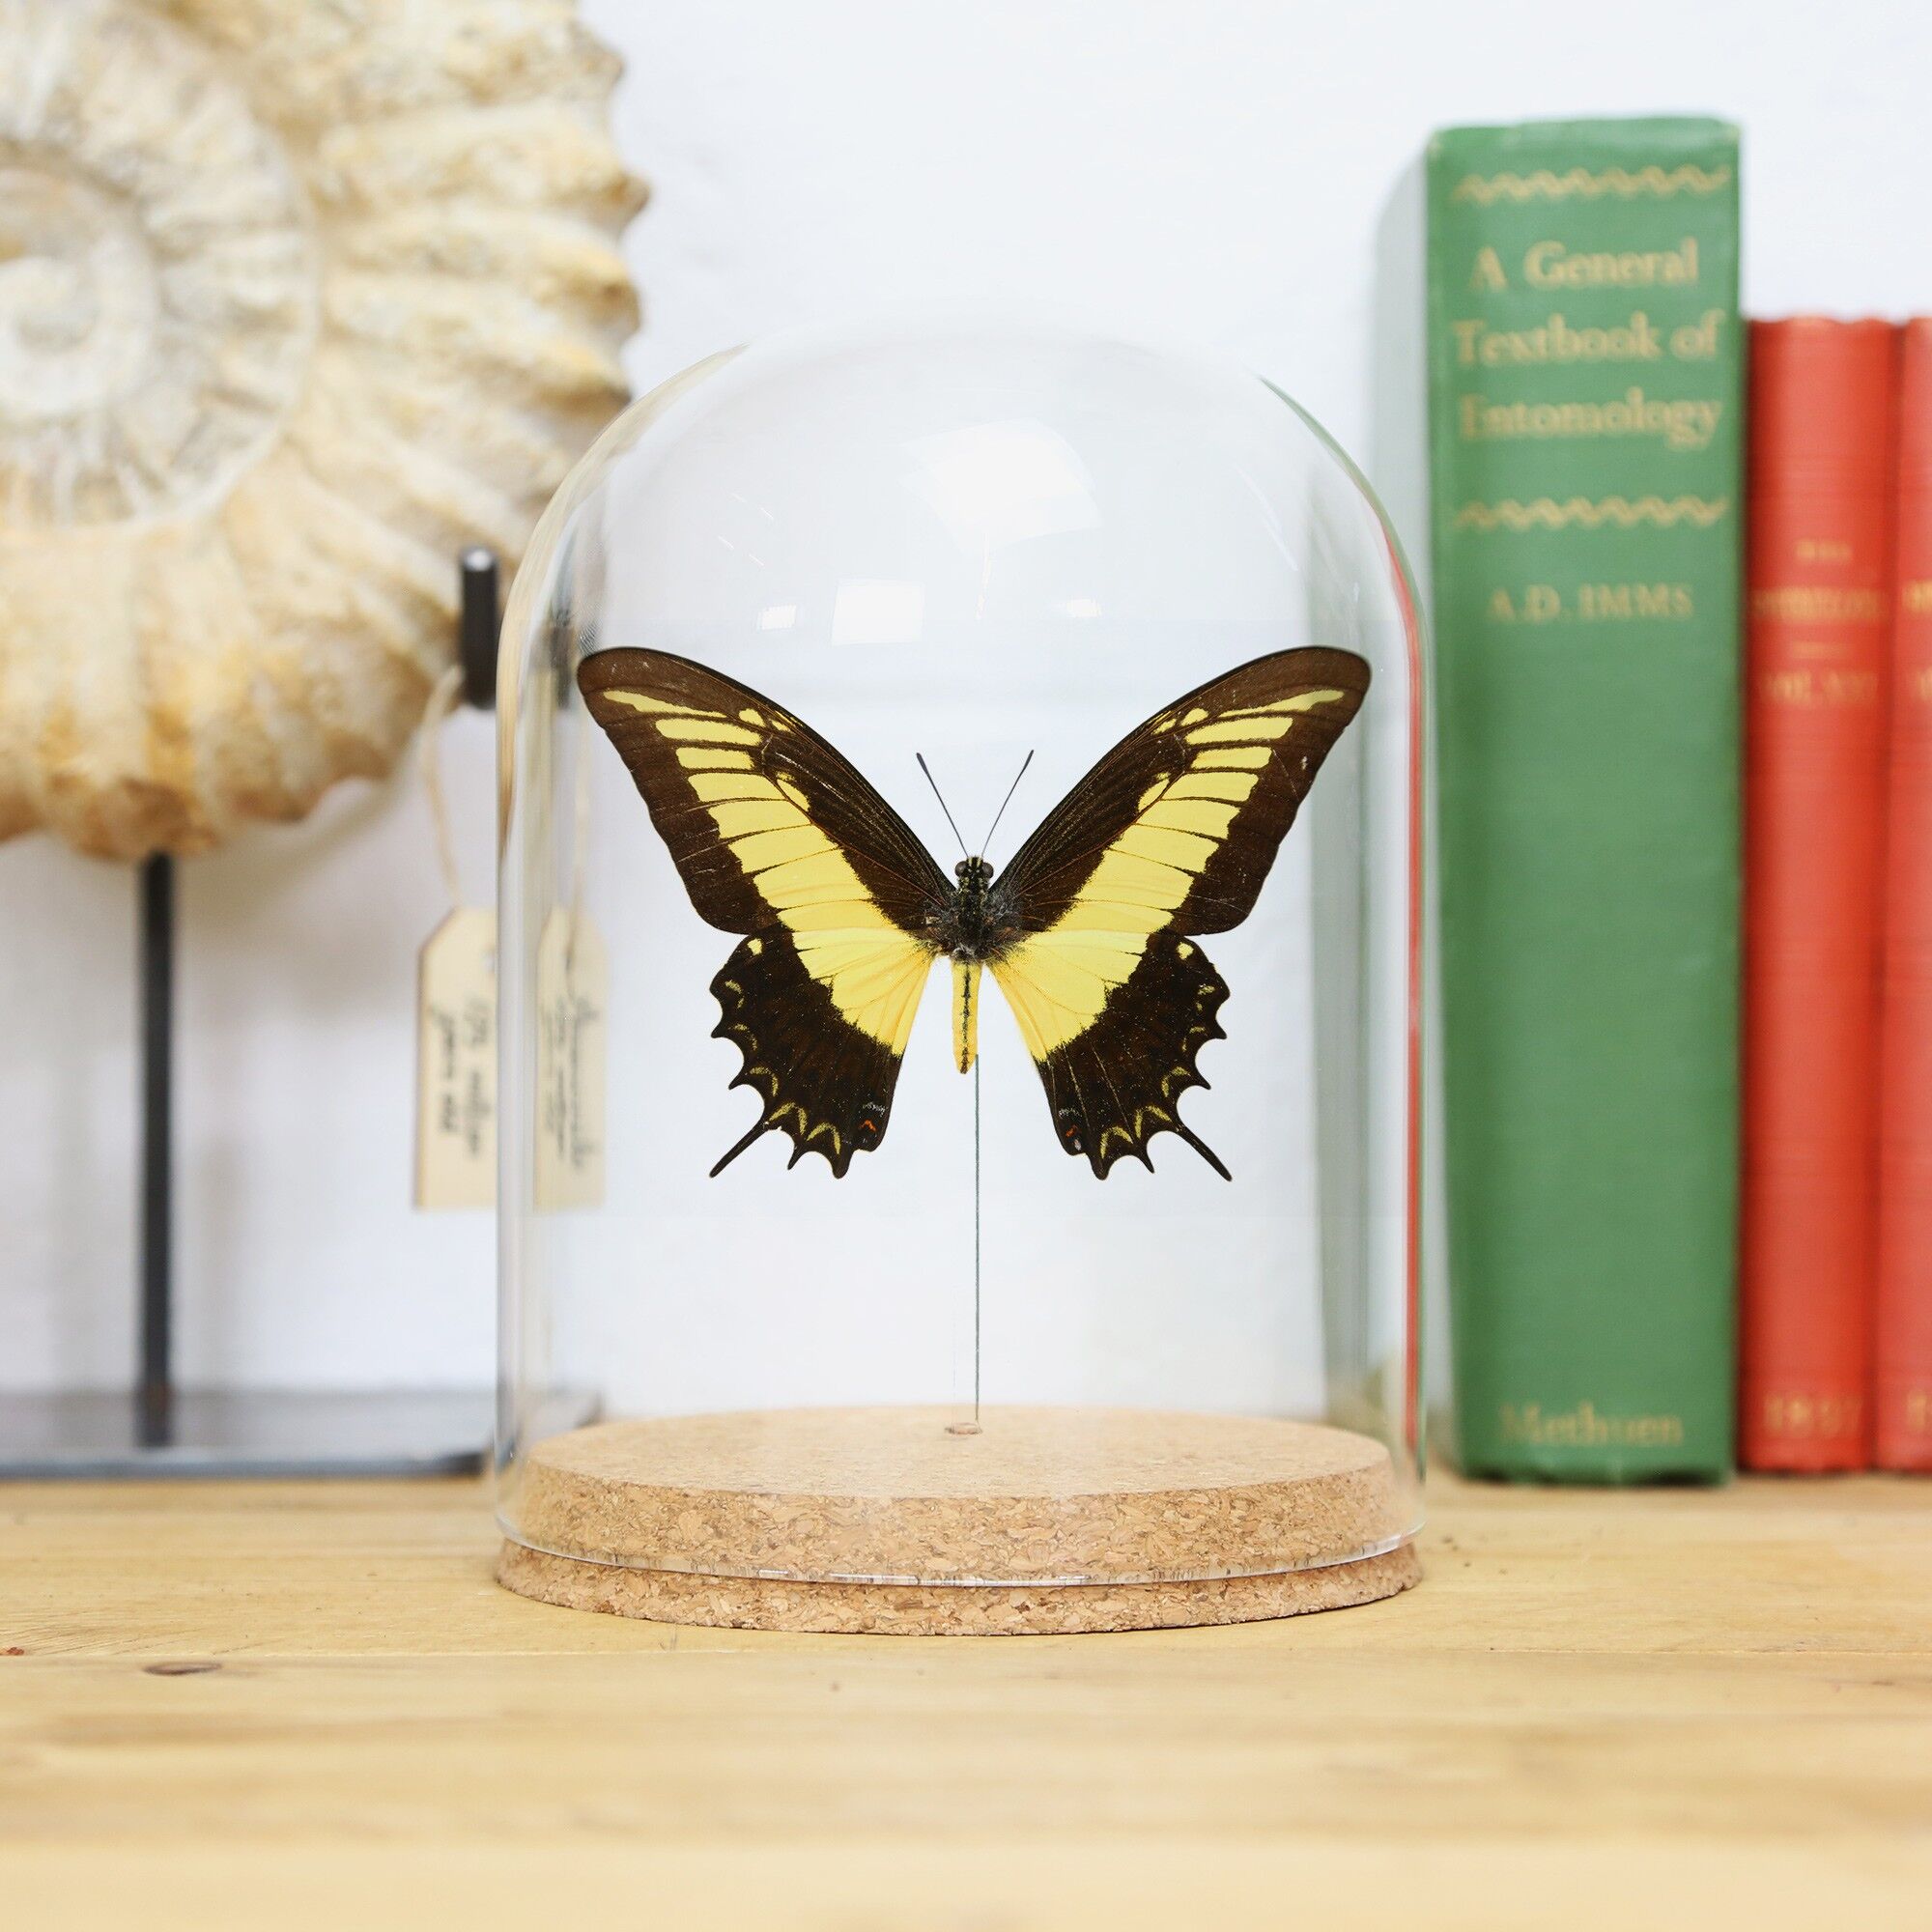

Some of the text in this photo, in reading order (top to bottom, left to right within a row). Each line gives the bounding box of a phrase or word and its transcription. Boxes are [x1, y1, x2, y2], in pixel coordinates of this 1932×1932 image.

[1468, 237, 1699, 292] A General
[1454, 308, 1727, 367] Textbook of
[1457, 387, 1723, 450] Entomology
[1578, 582, 1694, 620] IMMS
[1500, 1400, 1685, 1447] Methuen
